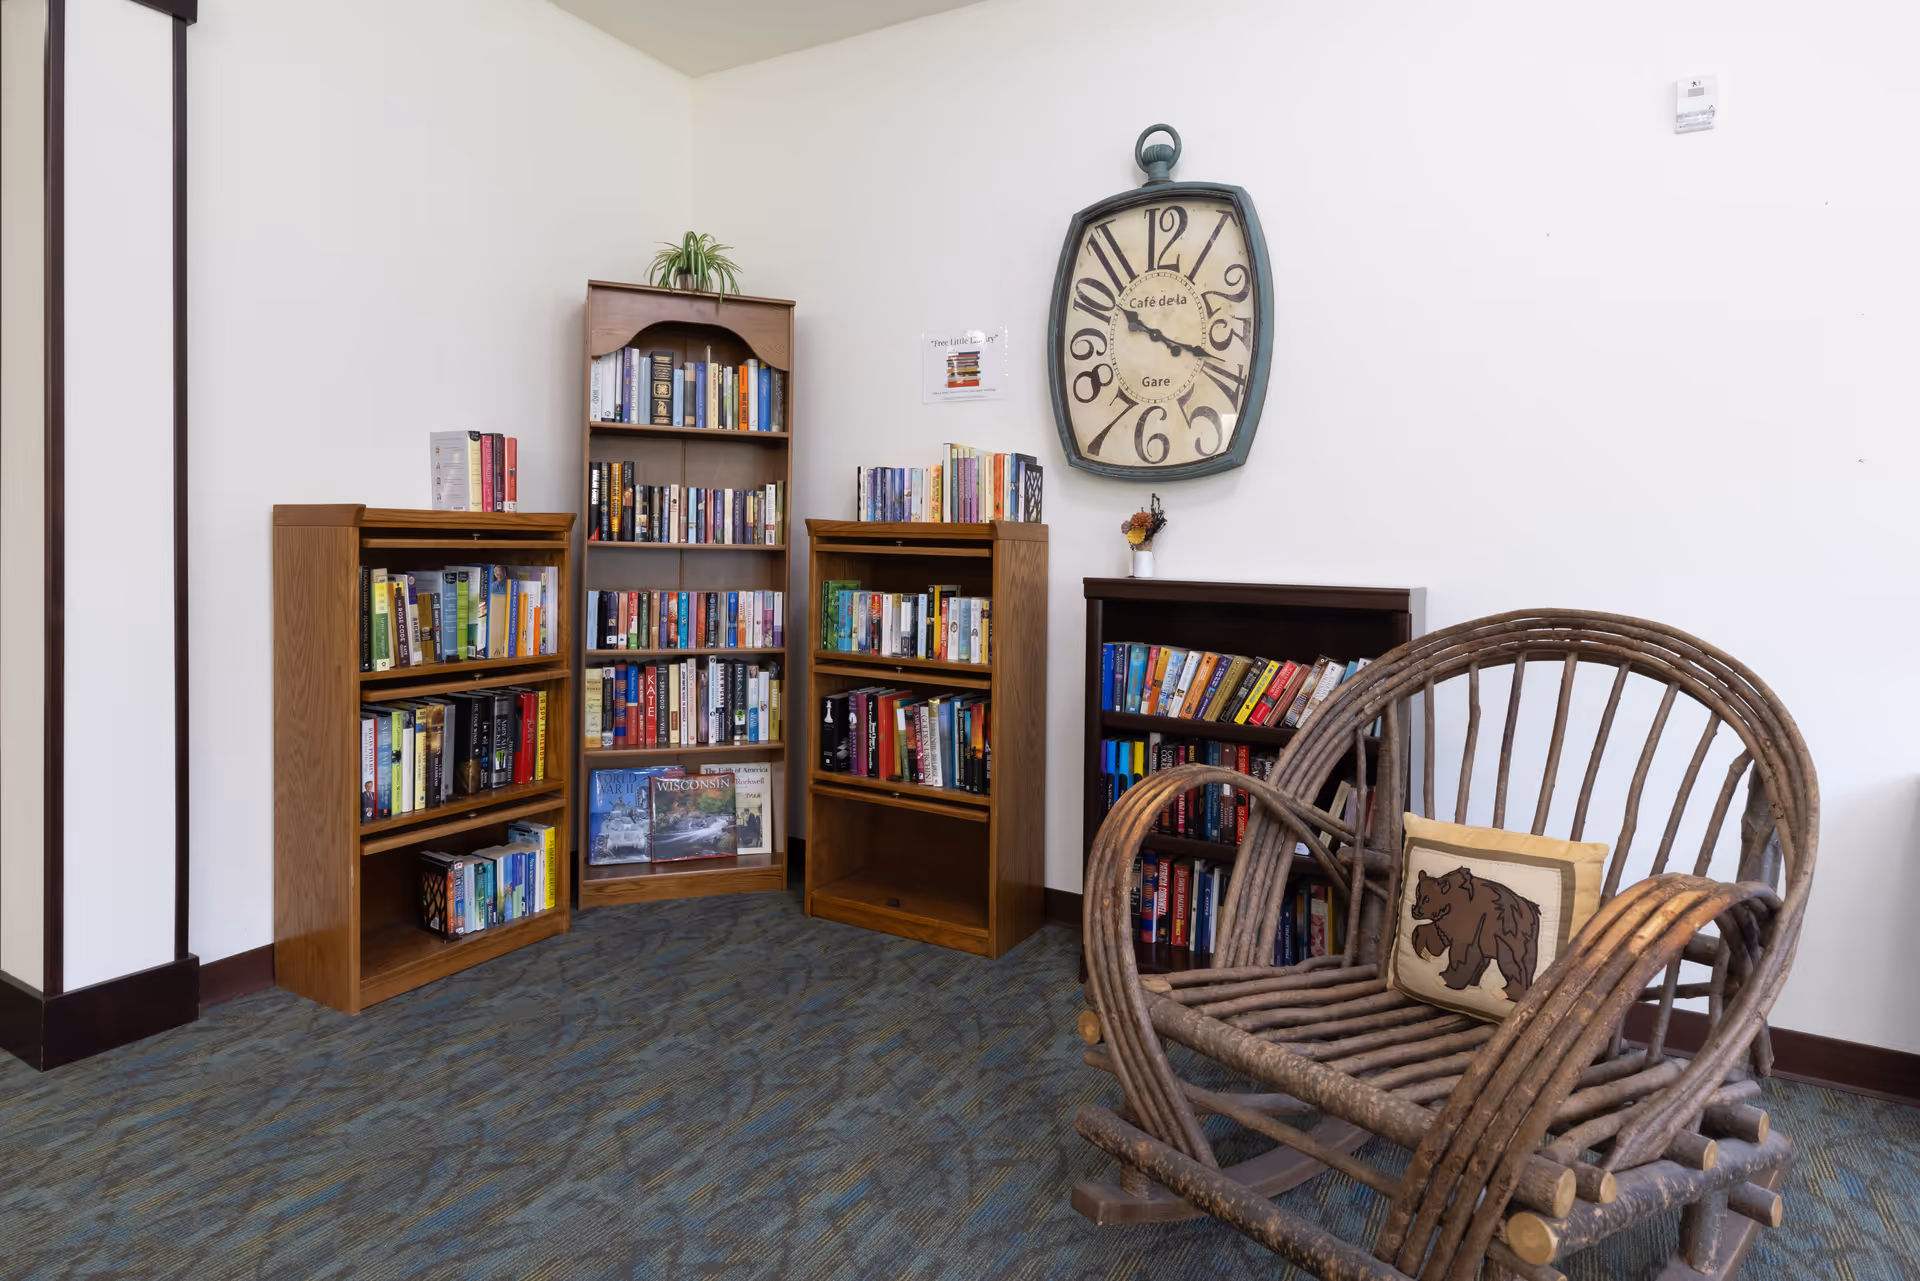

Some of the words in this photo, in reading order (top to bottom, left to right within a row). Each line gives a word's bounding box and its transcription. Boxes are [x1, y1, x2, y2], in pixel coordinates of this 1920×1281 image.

[1088, 219, 1139, 298] 11
[1144, 205, 1188, 273] 12
[1186, 210, 1239, 286] 1
[1073, 276, 1117, 326] 10
[1130, 295, 1156, 309] Café
[1202, 264, 1250, 318] 2
[950, 337, 968, 345] Little
[1070, 328, 1108, 363] 9
[1208, 314, 1252, 352] 3
[1072, 362, 1114, 404] 8
[1142, 376, 1170, 388] Gare
[1200, 362, 1248, 412] 4
[1088, 386, 1139, 456] 7
[1134, 406, 1170, 464] 6
[1178, 383, 1222, 456] 5
[647, 675, 655, 716] KATE
[625, 782, 634, 794] II
[657, 778, 730, 791] WISCONSIN
[1144, 866, 1153, 880] TOM
[1159, 862, 1168, 885] PATRICIA
[1158, 887, 1167, 915] CORNWELL
